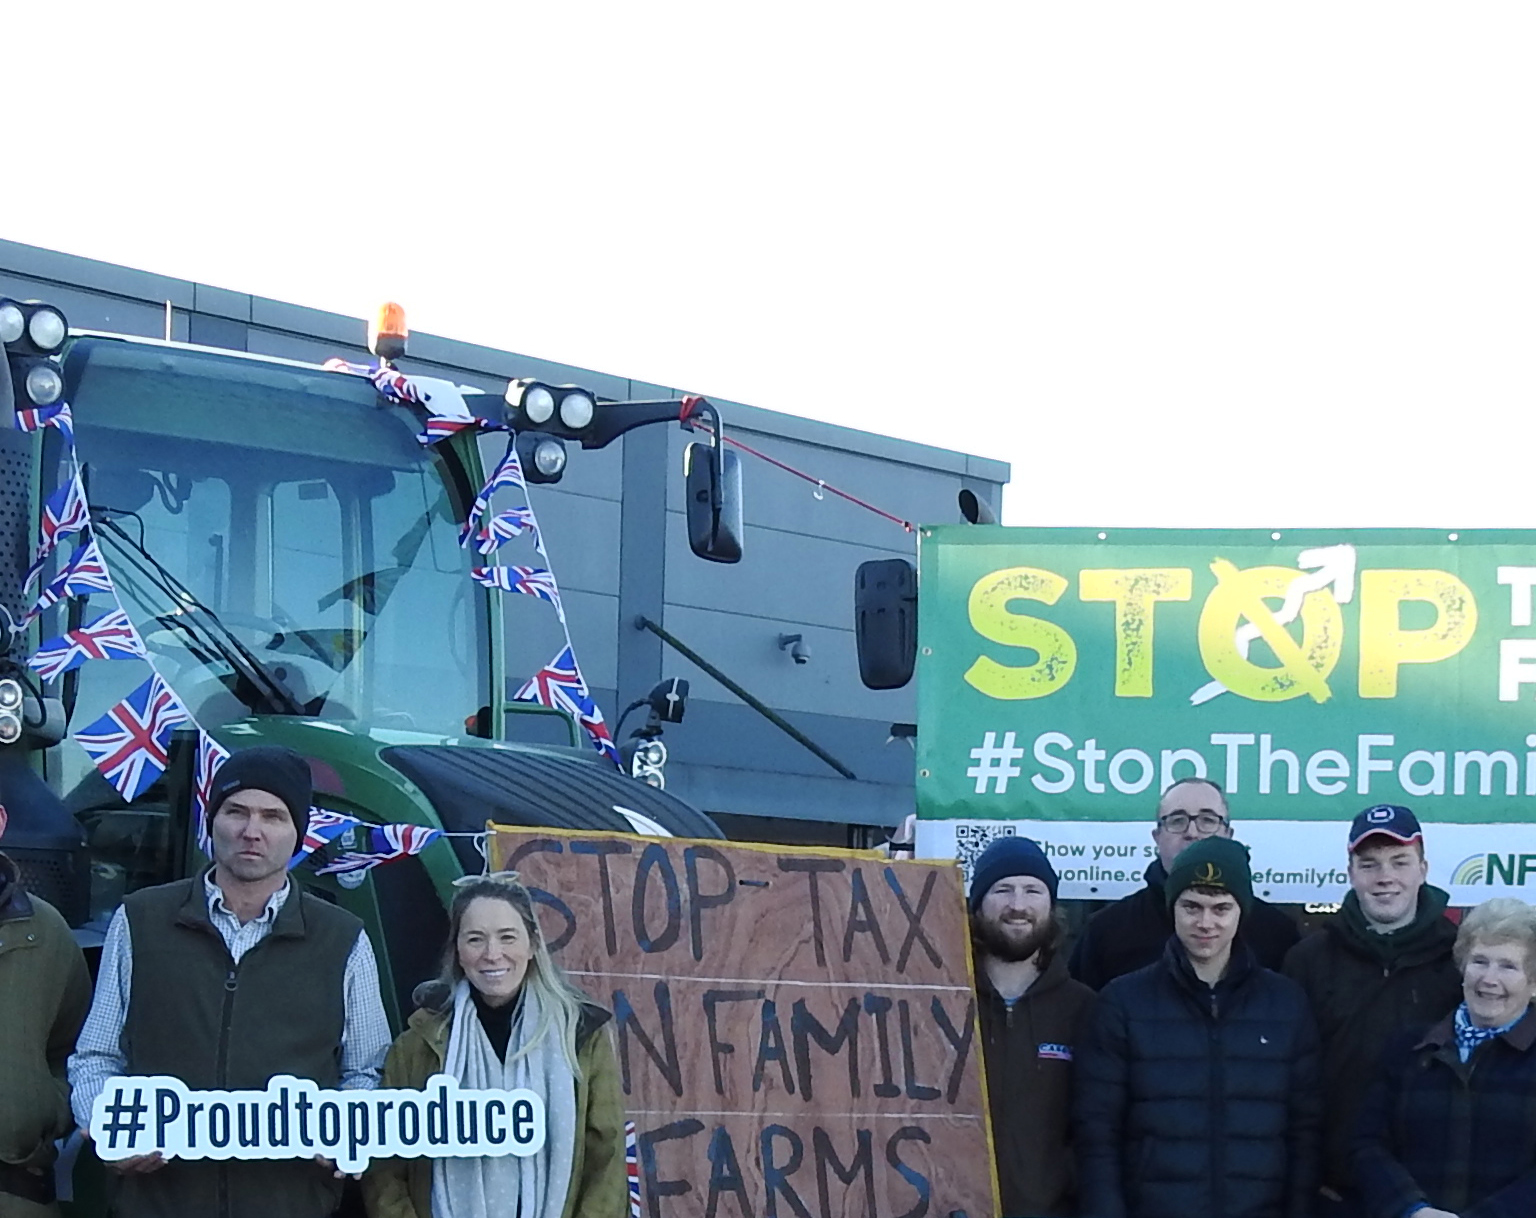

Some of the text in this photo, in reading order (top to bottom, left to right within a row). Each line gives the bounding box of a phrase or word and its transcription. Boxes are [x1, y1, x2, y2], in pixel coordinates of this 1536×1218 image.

[964, 558, 1478, 704] STOP
[1035, 840, 1086, 857] how
[1092, 844, 1137, 861] your
[612, 982, 976, 1105] N FAMILY
[102, 1085, 535, 1161] #Proudtoproduce
